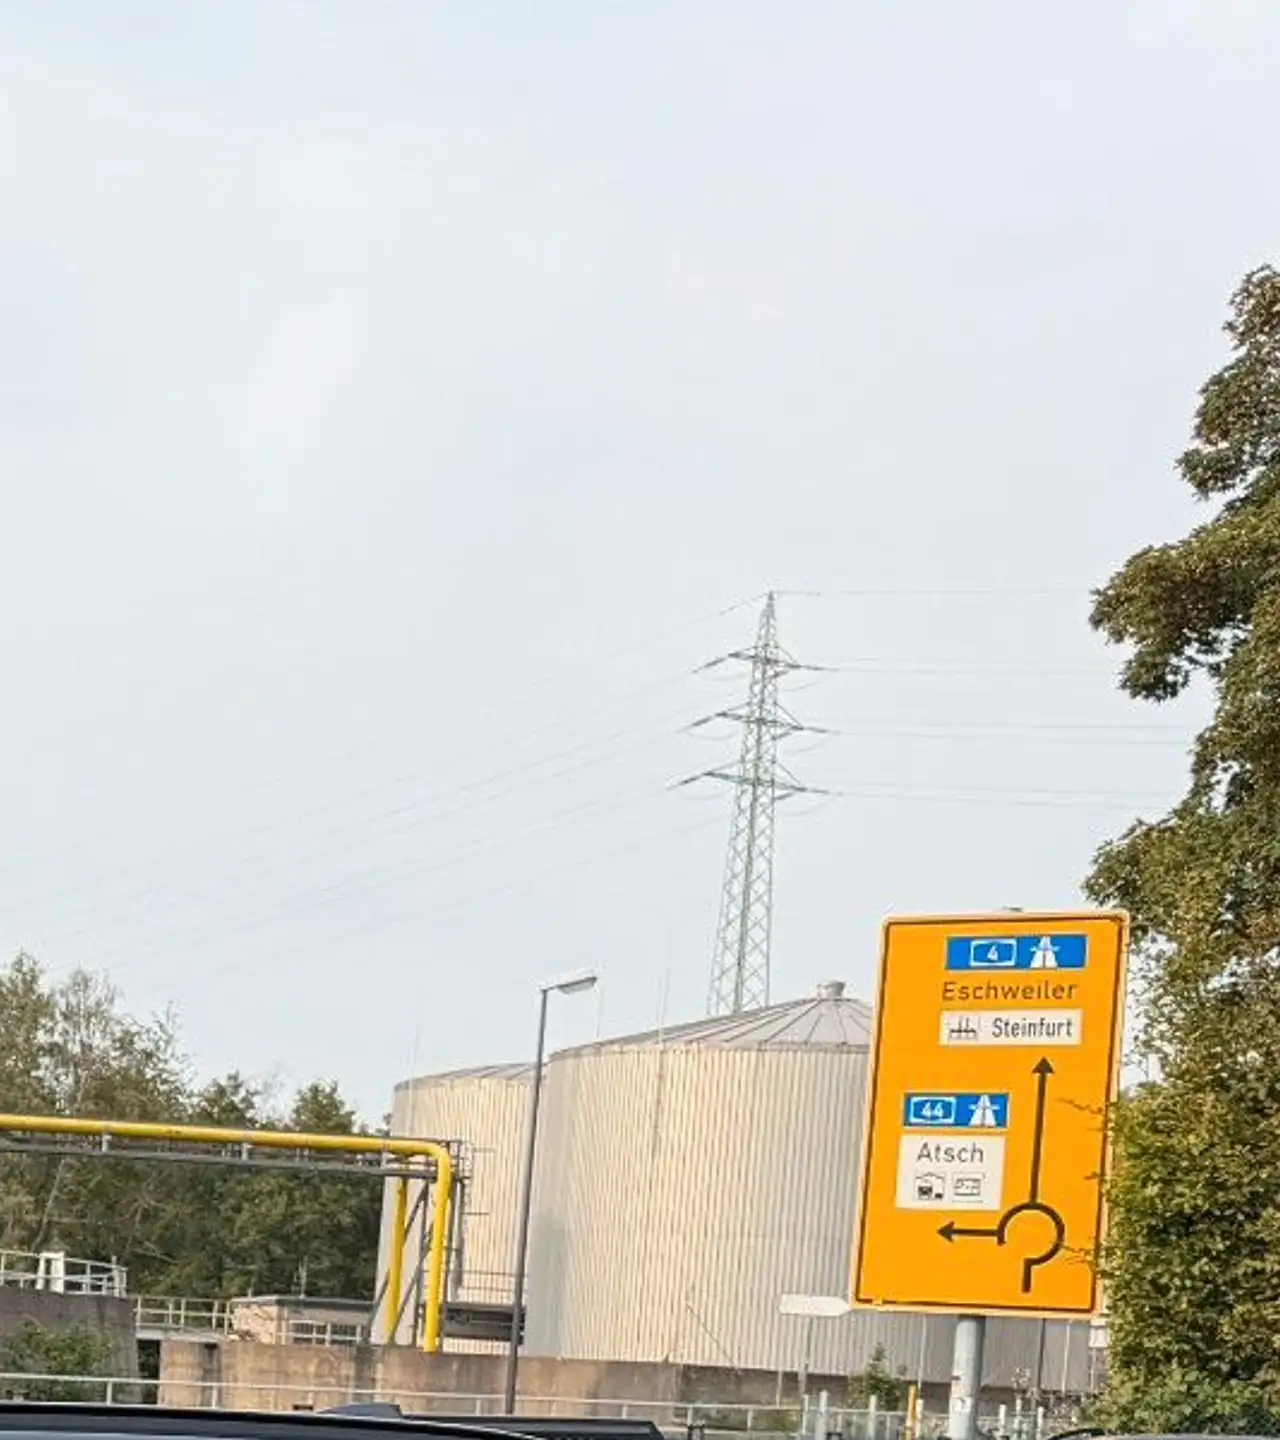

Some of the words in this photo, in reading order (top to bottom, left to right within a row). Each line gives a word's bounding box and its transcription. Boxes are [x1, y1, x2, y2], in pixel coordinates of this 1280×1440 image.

[987, 944, 999, 961] 4
[942, 980, 1078, 1001] Eschweiler
[992, 1017, 1073, 1038] Steinfurt
[921, 1101, 944, 1118] 44
[916, 1142, 984, 1163] Atsch
